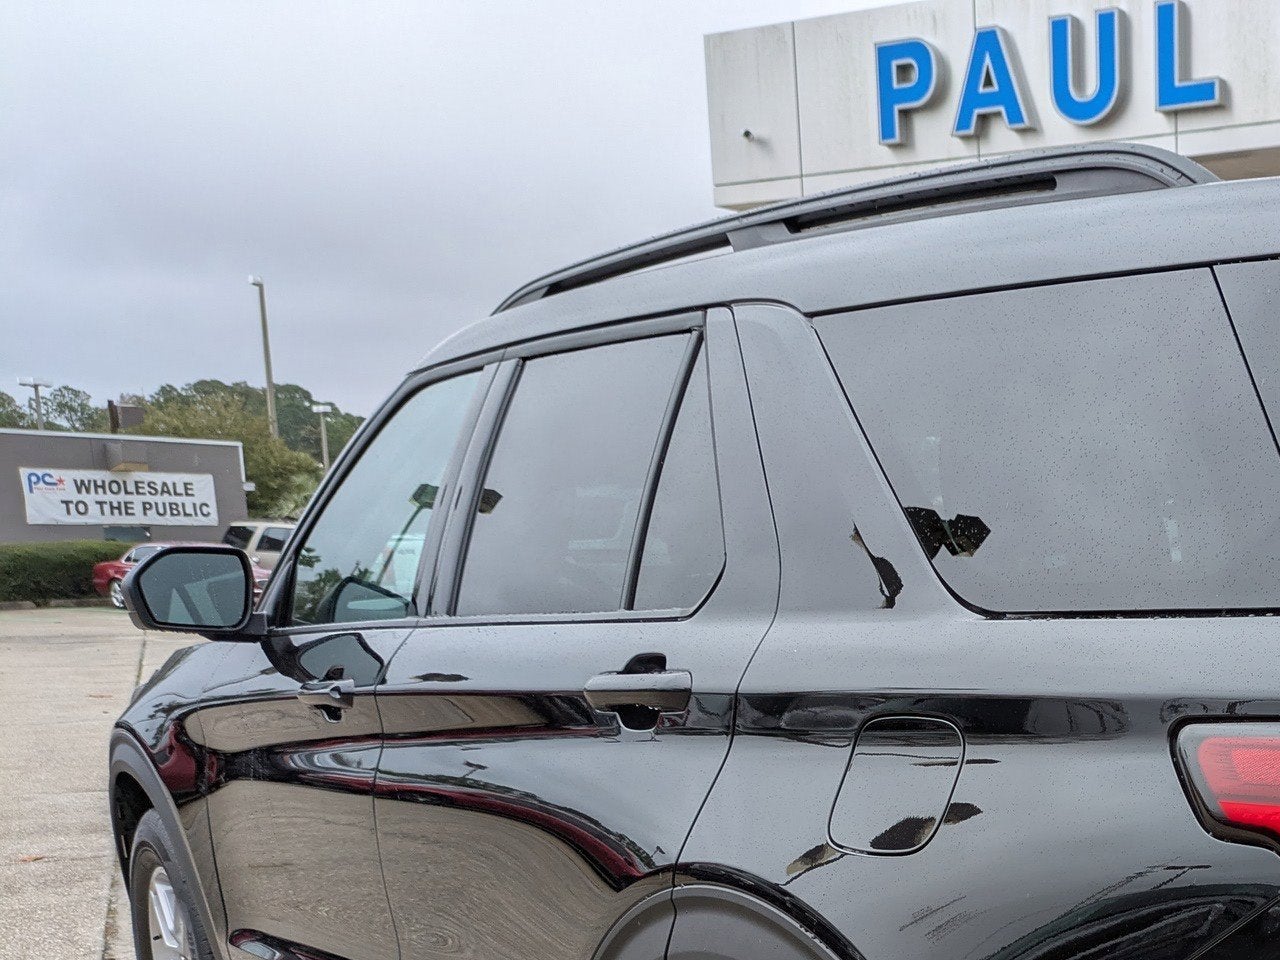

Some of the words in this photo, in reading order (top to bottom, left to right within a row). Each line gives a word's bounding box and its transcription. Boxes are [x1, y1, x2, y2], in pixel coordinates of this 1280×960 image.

[874, 0, 1226, 145] PAUL
[73, 479, 196, 497] WHOLESALE
[61, 499, 90, 516] TO
[95, 500, 136, 517] THE
[142, 502, 211, 518] PUBLIC
